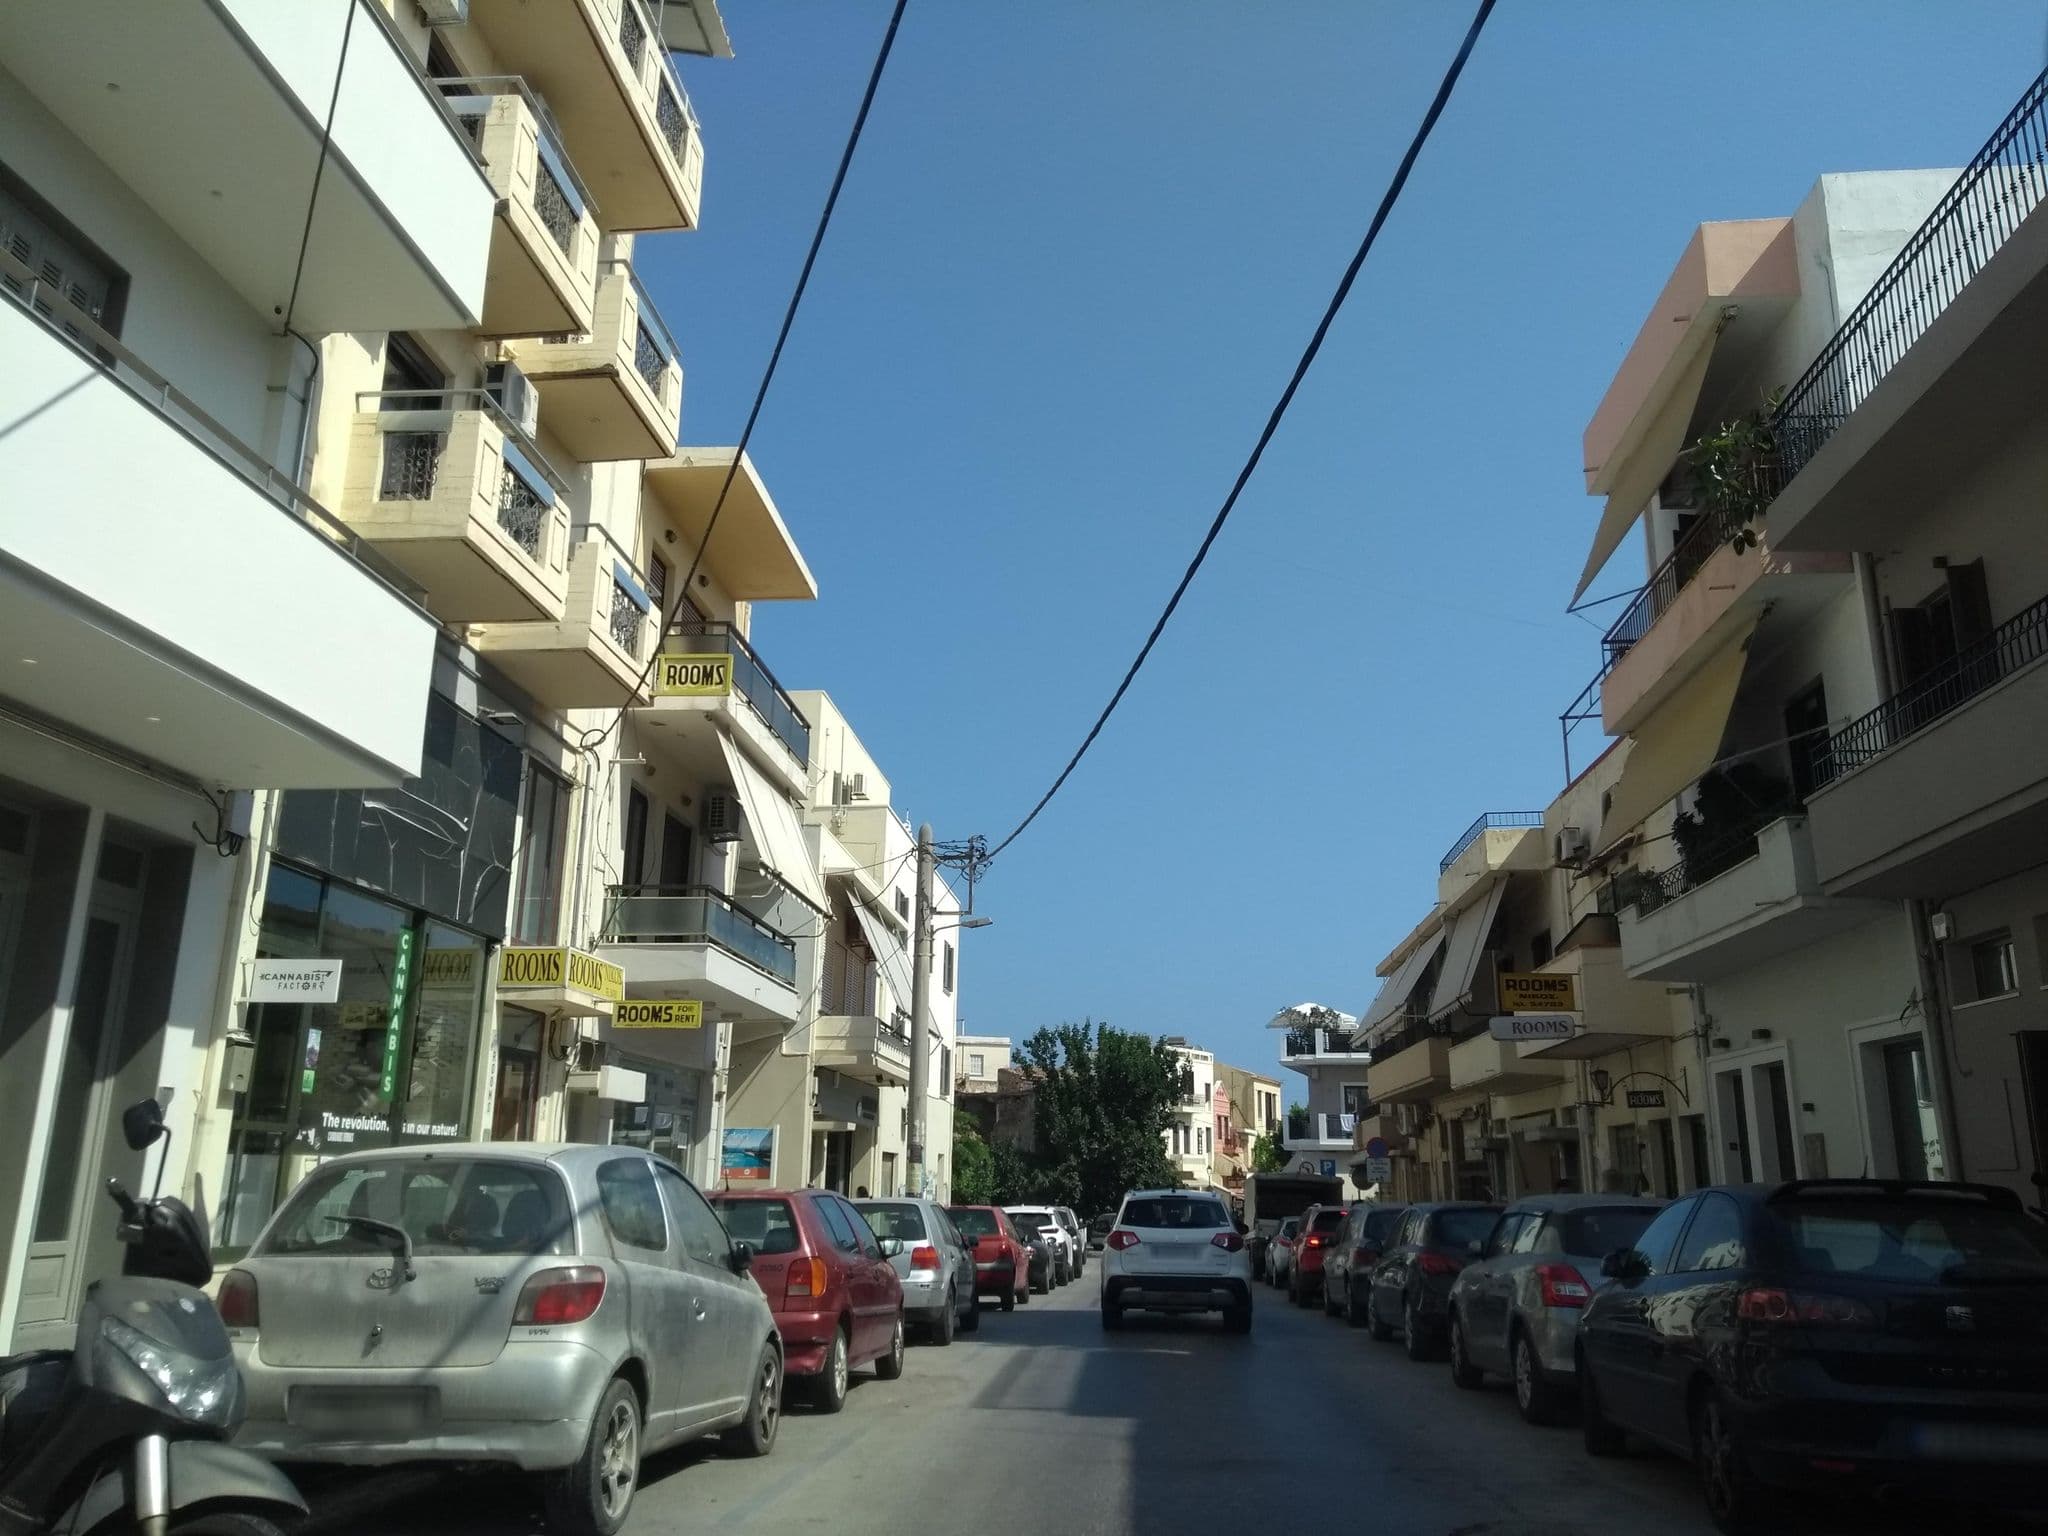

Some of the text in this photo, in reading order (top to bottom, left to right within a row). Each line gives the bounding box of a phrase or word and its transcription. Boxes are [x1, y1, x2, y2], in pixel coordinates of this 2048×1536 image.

[666, 664, 726, 686] ROOMS
[503, 952, 561, 981] ROOMS
[568, 953, 603, 990] ROOMS
[1505, 979, 1569, 992] ROOMS
[384, 934, 410, 1092] CANNABIS
[617, 1005, 673, 1023] ROOMS
[675, 1014, 696, 1023] RENT
[1512, 1021, 1569, 1035] ROOMS
[322, 1112, 340, 1128] The
[417, 1124, 430, 1135] our
[432, 1124, 459, 1136] nature!
